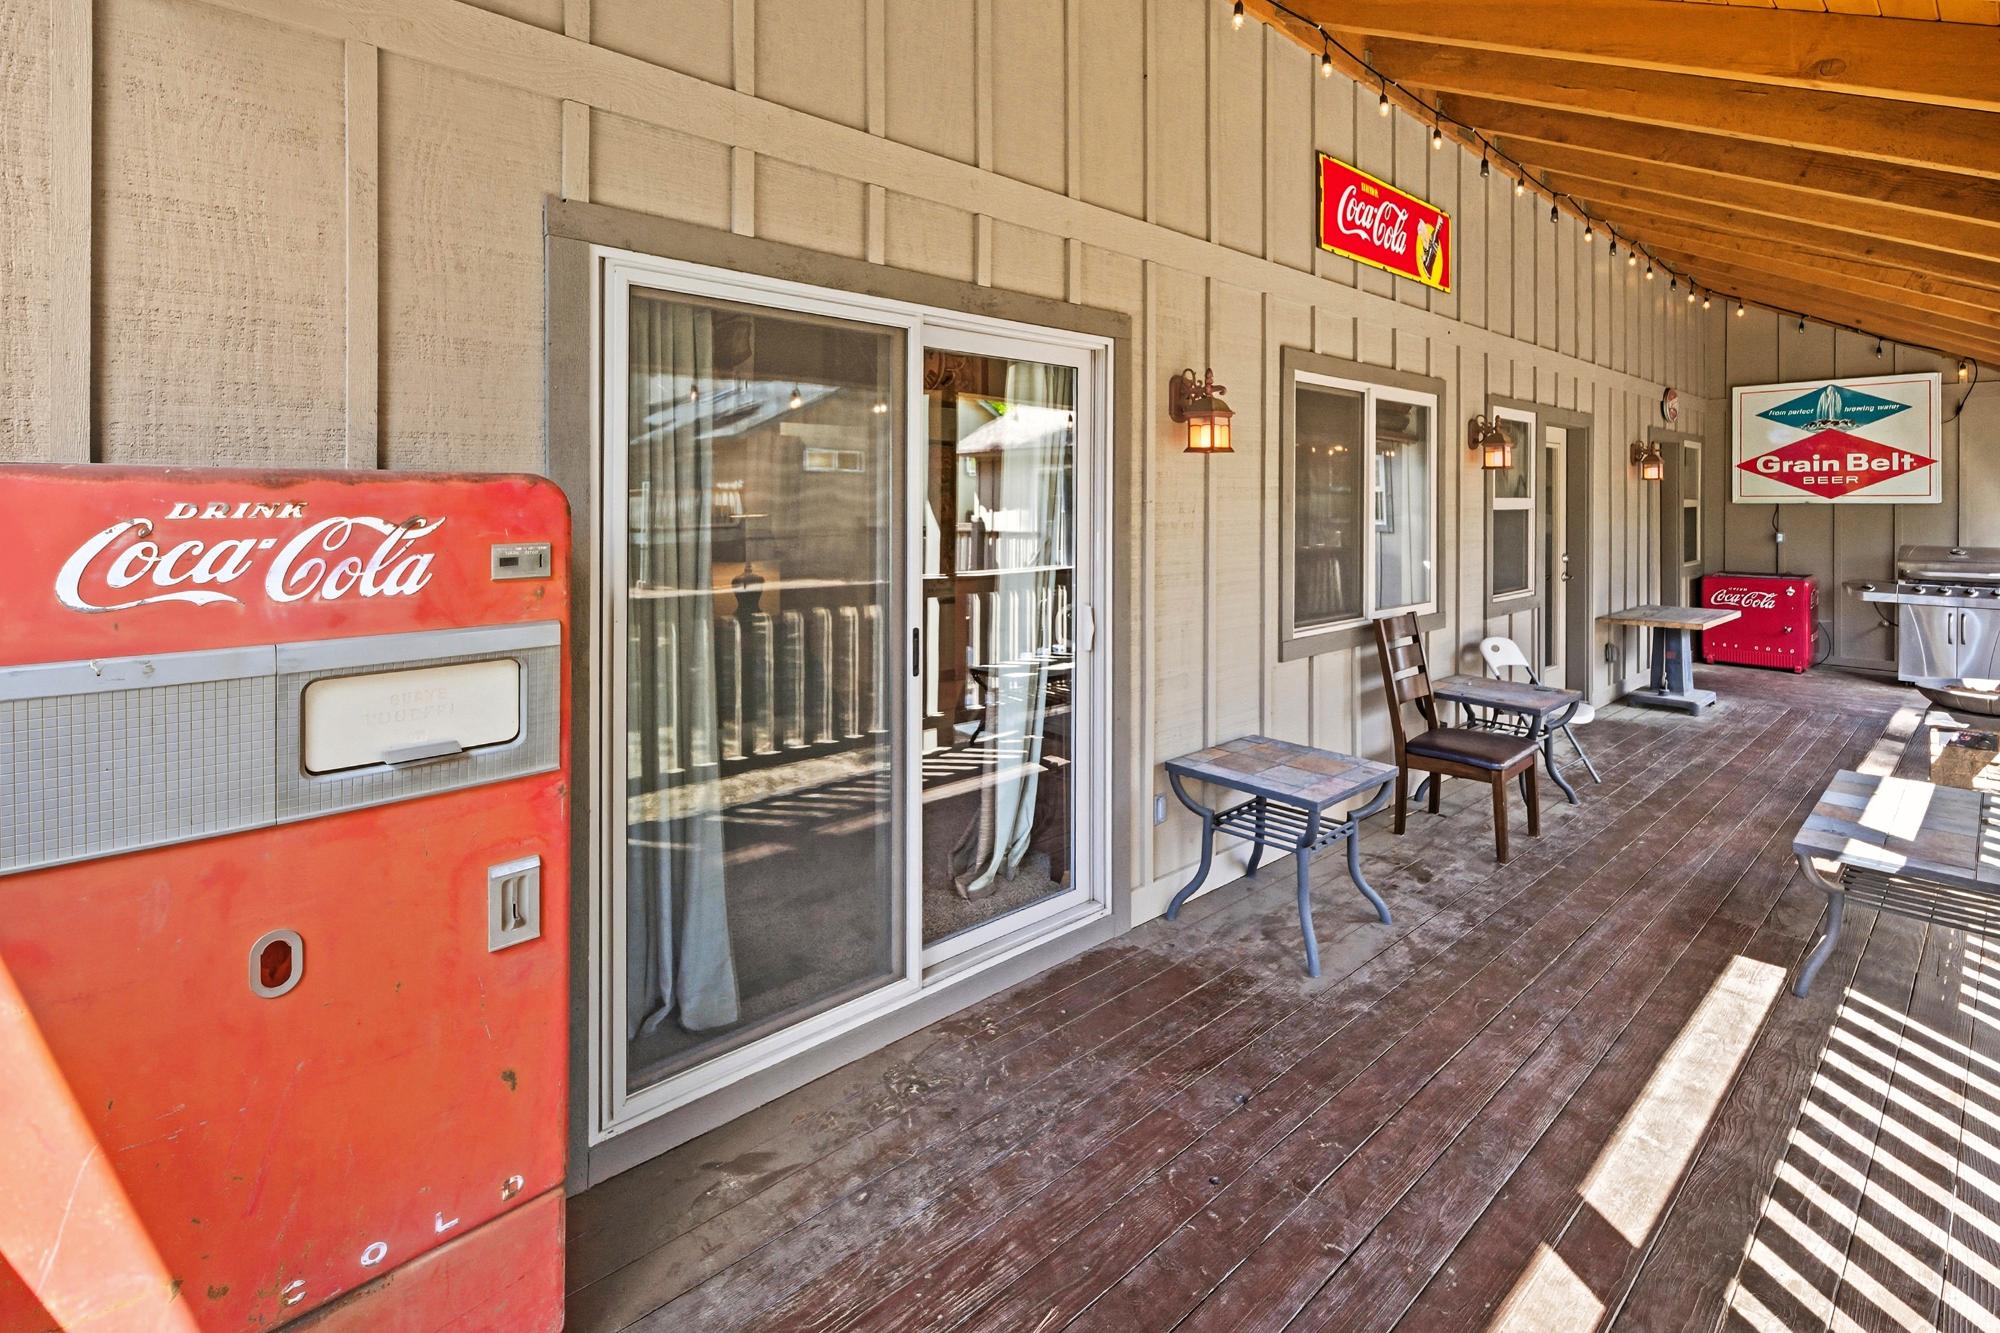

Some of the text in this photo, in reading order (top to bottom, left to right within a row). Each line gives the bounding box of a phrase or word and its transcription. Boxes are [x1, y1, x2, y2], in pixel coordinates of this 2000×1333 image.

[1337, 185, 1408, 255] Coca-Cola
[1756, 452, 1915, 474] Grain Belt
[1803, 476, 1859, 485] BEER
[164, 502, 309, 520] DRINK
[54, 516, 447, 614] Coca-Cola
[1710, 588, 1778, 609] Coca-Cola
